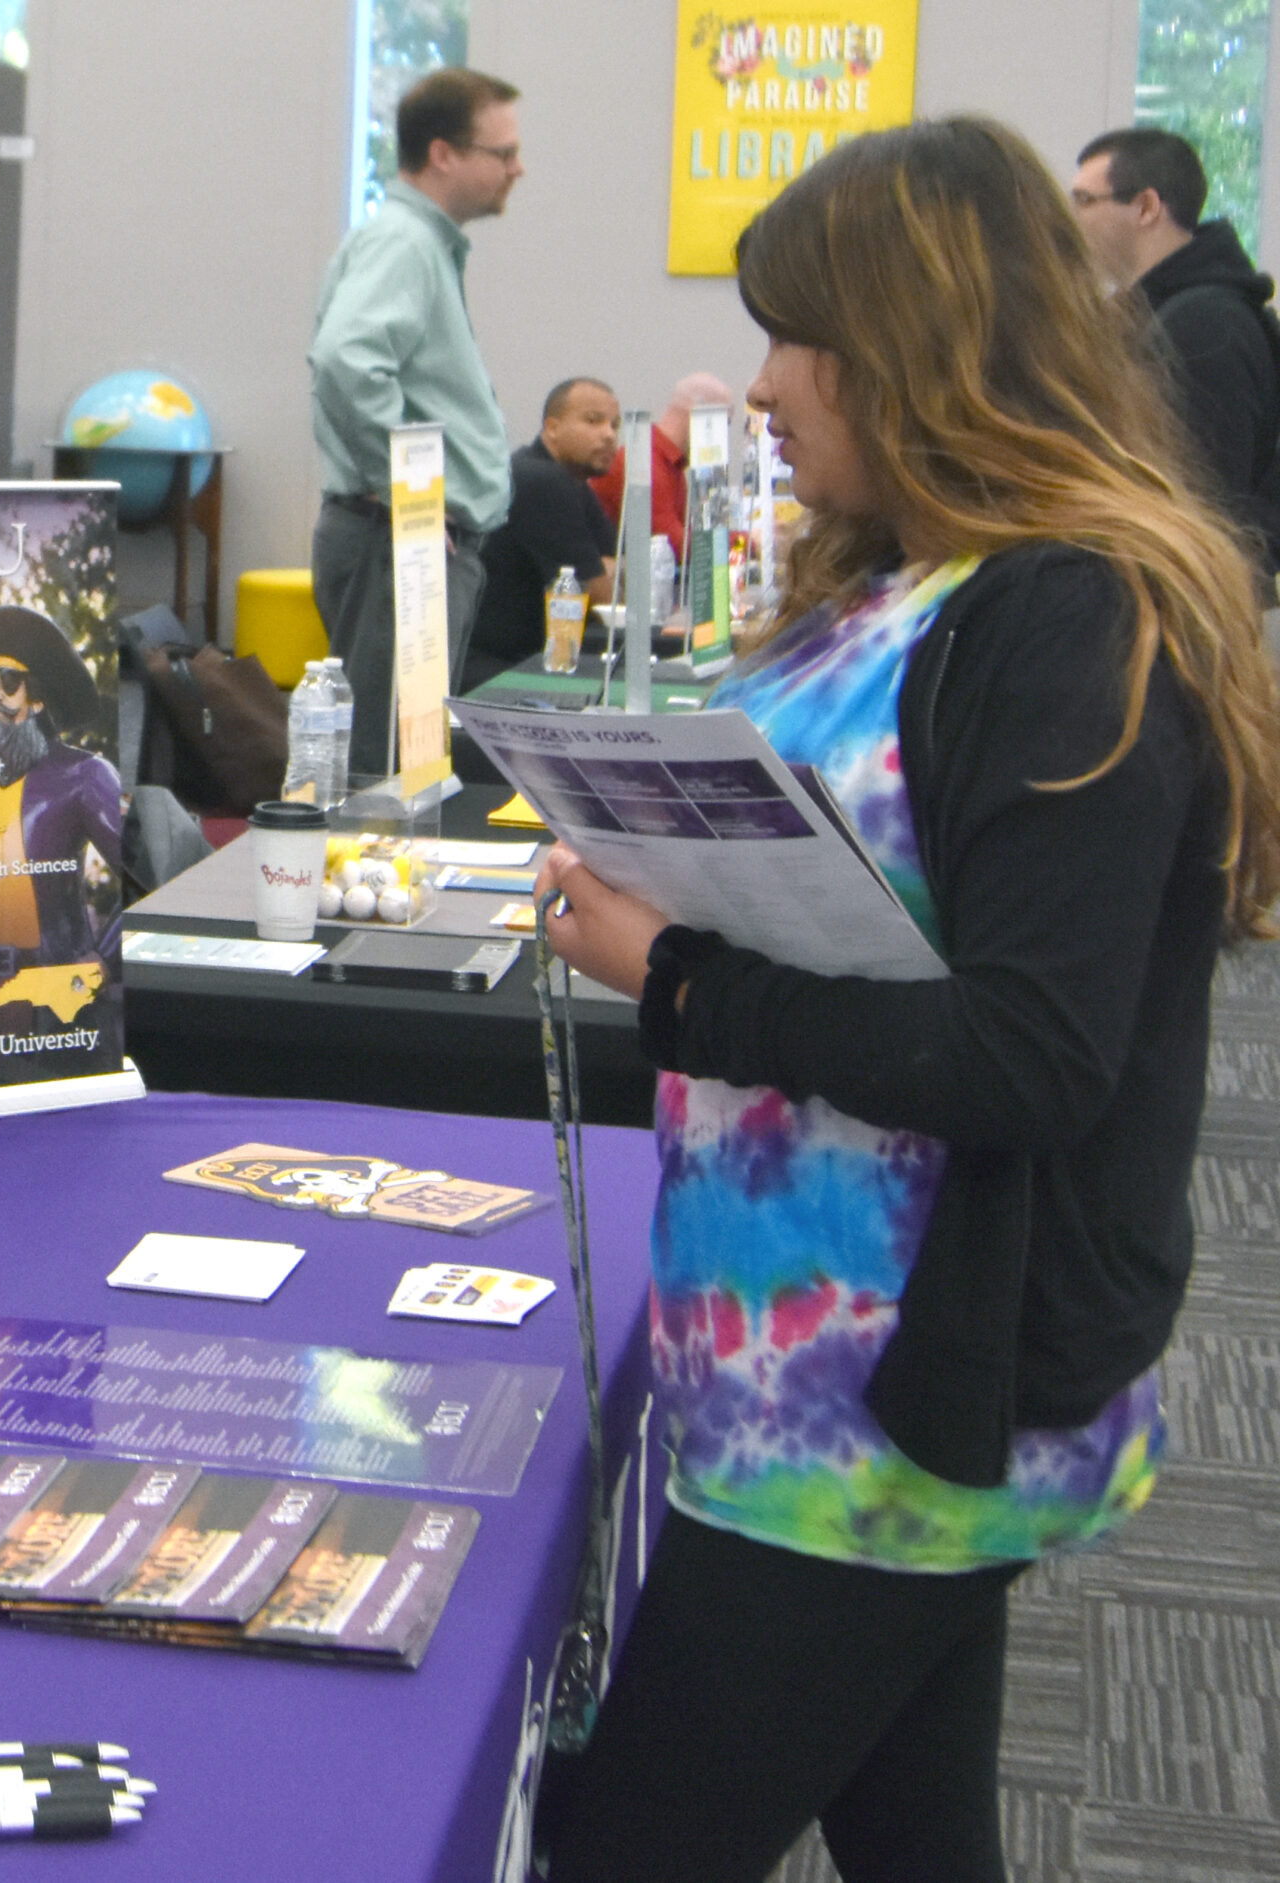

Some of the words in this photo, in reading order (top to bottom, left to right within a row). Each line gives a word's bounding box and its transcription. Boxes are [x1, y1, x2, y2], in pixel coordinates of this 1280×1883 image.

[719, 24, 884, 63] IMAGINED
[726, 79, 871, 112] PARADISE
[691, 129, 858, 181] LIBRA
[11, 858, 77, 875] Sciences
[233, 1162, 278, 1181] ECU
